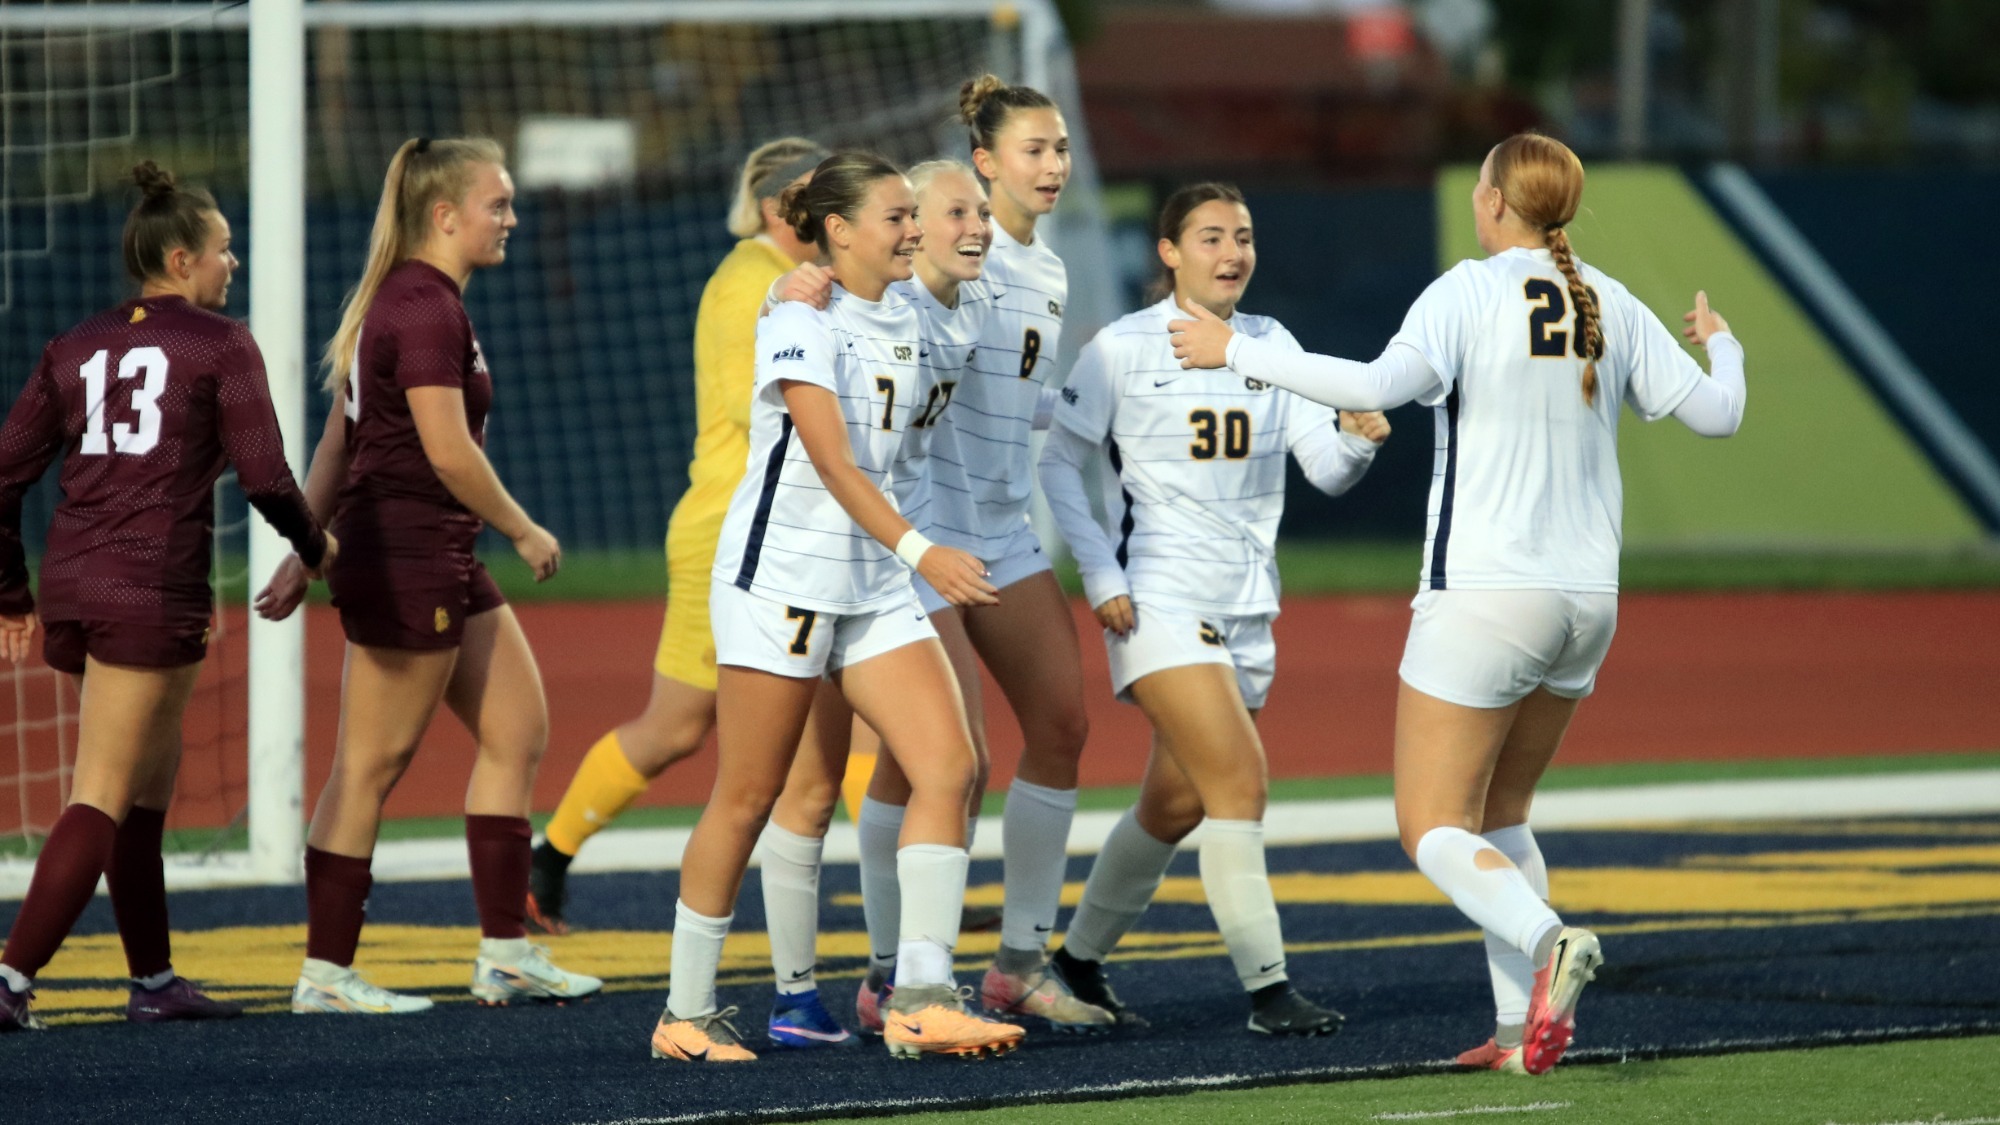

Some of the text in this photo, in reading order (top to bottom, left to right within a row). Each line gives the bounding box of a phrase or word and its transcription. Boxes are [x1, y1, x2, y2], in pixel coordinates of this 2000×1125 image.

[1019, 327, 1041, 380] 8
[79, 346, 168, 455] 13
[875, 375, 895, 432] 7
[1188, 408, 1252, 461] 30
[785, 605, 816, 657] 7
